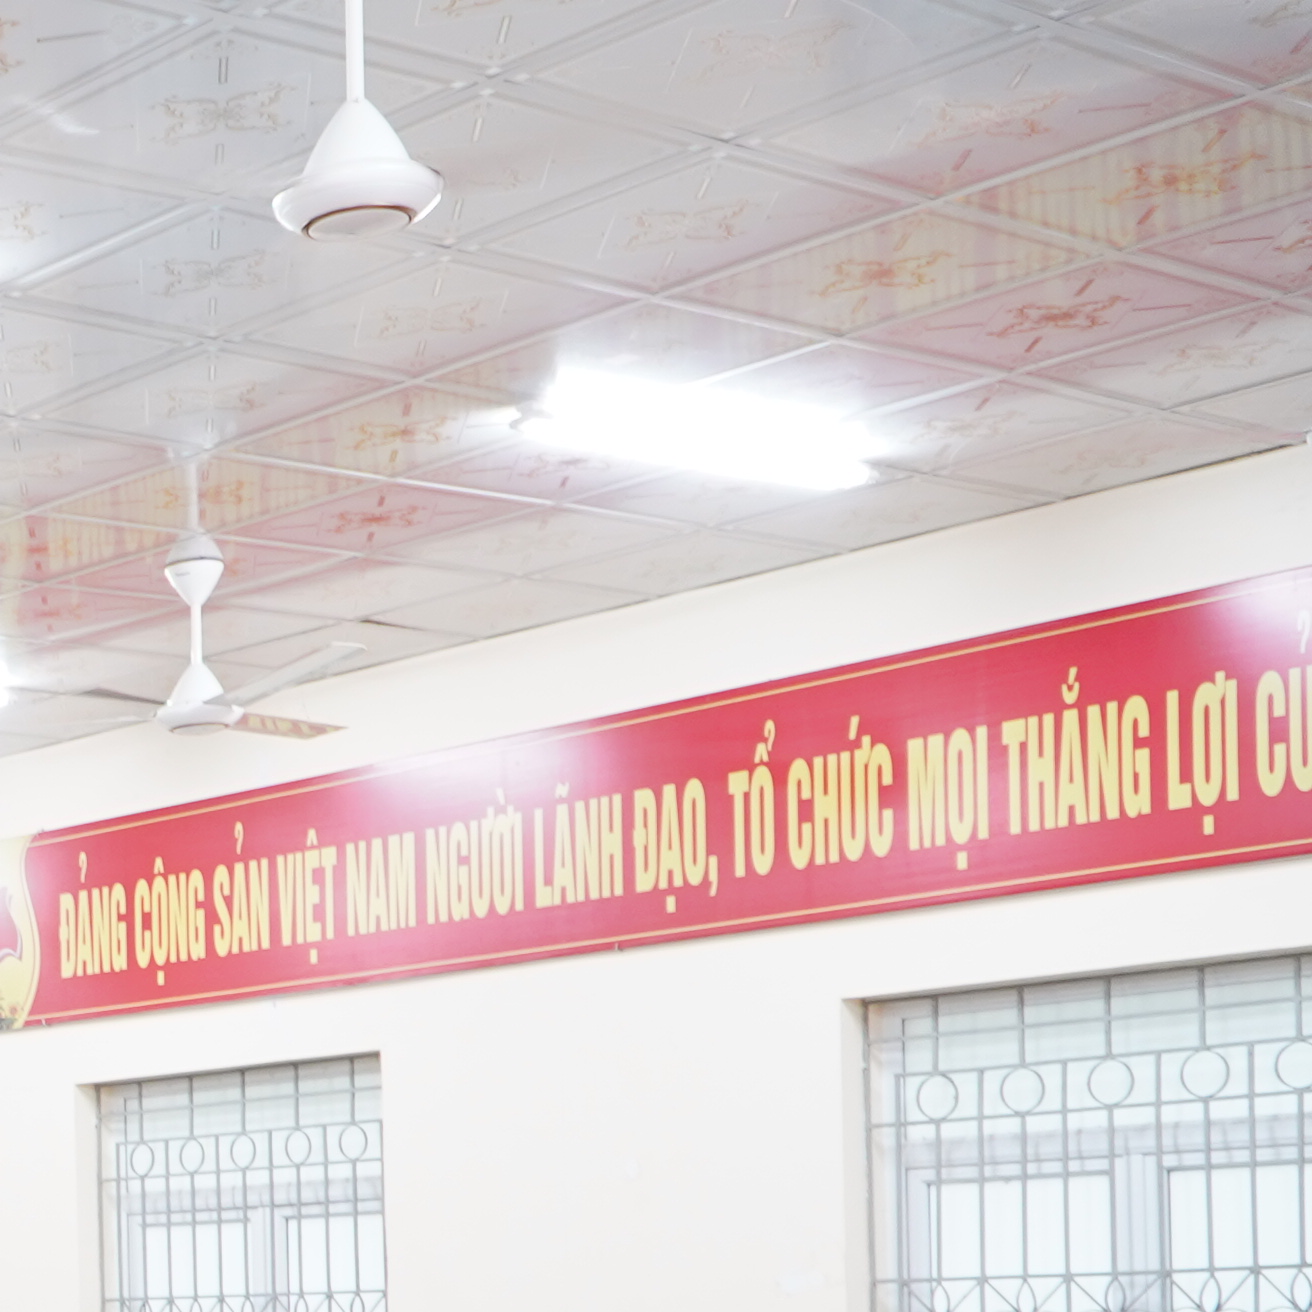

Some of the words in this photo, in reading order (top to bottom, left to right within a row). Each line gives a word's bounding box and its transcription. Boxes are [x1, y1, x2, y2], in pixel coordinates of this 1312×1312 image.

[59, 851, 128, 979] ĐẢNG
[134, 856, 207, 986] CỘNG
[213, 821, 271, 957] SẢN
[276, 828, 337, 965] VIỆT
[345, 831, 416, 937] NAM
[426, 787, 525, 925] NGƯỜI
[534, 782, 624, 909] LÃNH
[633, 778, 719, 914] ĐẠO,
[728, 719, 776, 878] TỔ
[787, 715, 894, 870] CHỨC
[907, 725, 990, 870] MỌI
[1001, 666, 1152, 835] THẮNG
[1166, 670, 1240, 835] LỢI
